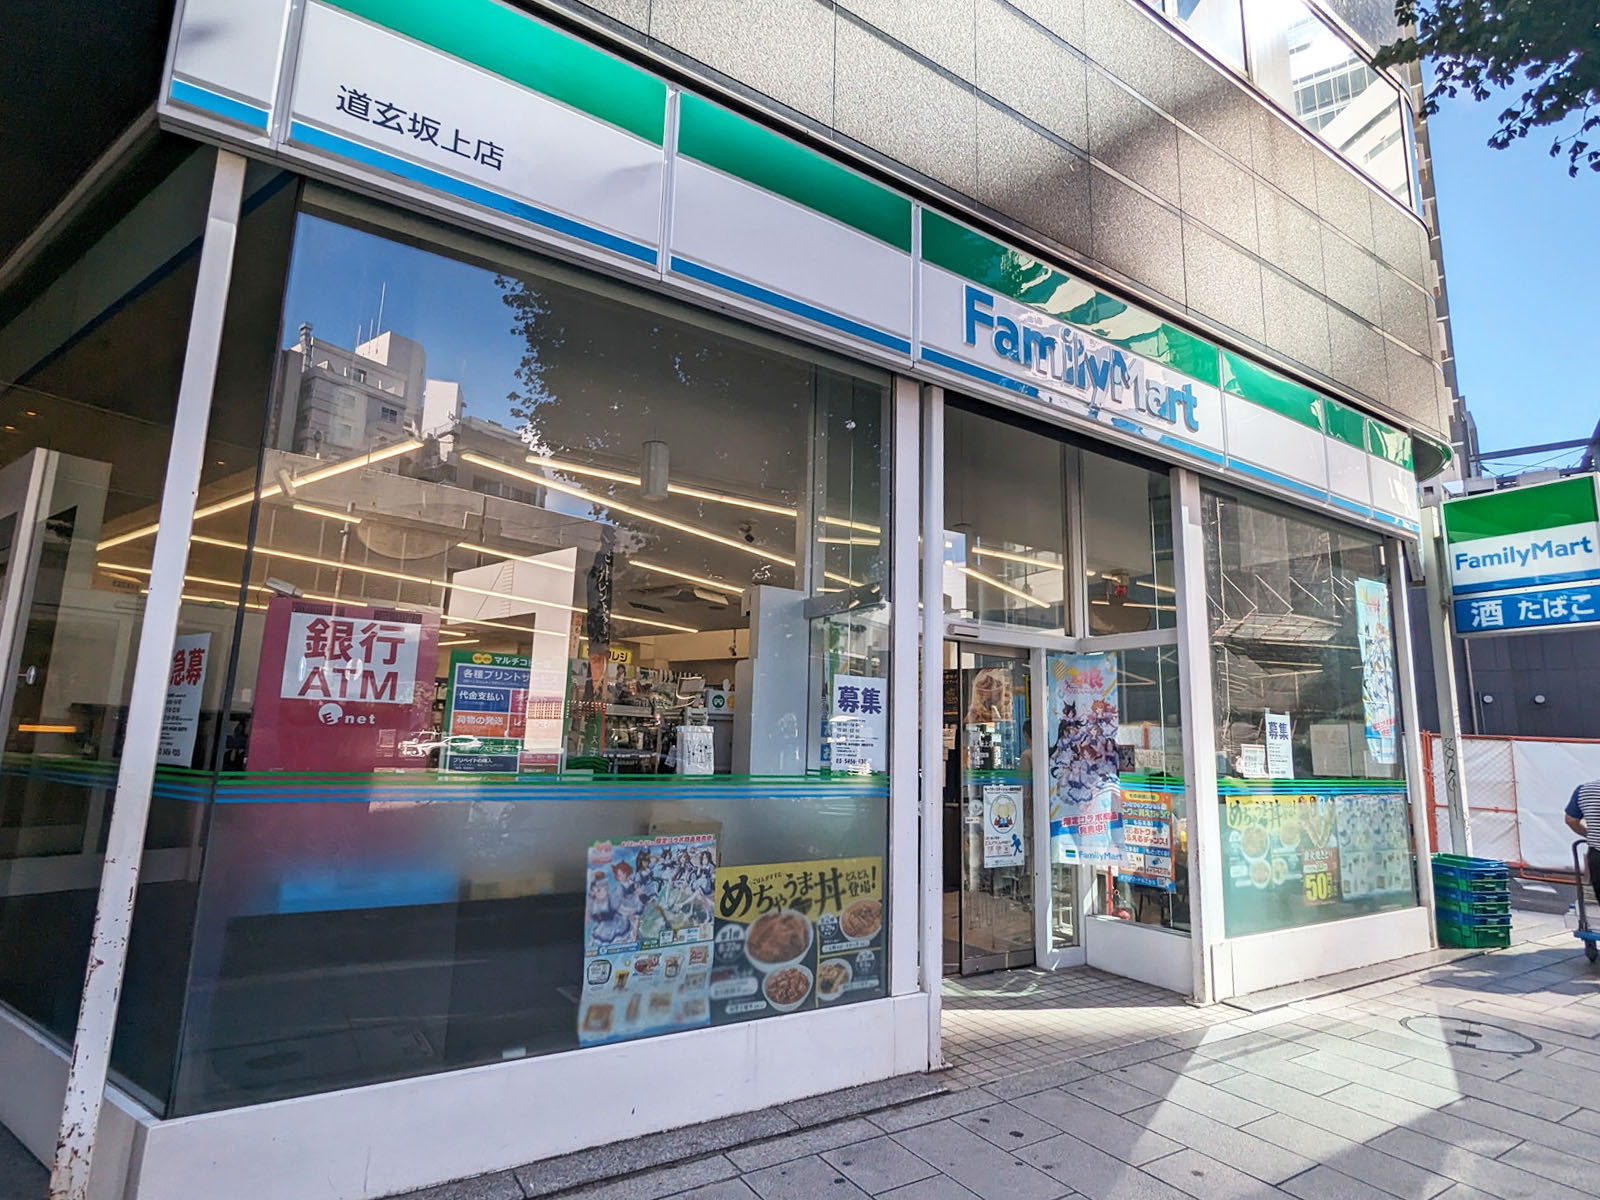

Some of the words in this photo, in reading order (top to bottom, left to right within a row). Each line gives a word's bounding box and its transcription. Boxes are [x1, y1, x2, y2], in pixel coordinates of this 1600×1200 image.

[336, 85, 504, 171] 道玄坂上店
[963, 284, 1199, 432] FamilyMart
[1455, 536, 1593, 571] FamilyMart
[1471, 599, 1504, 627] 酒
[1517, 594, 1595, 621] たばこ
[304, 618, 406, 665] 銀行
[297, 667, 399, 701] ATM
[459, 690, 504, 702] 代金支払い
[837, 685, 882, 714] 募集
[1267, 720, 1290, 741] 募集
[1078, 850, 1124, 861] FamilyMart
[719, 867, 847, 919] めちゃうま丼
